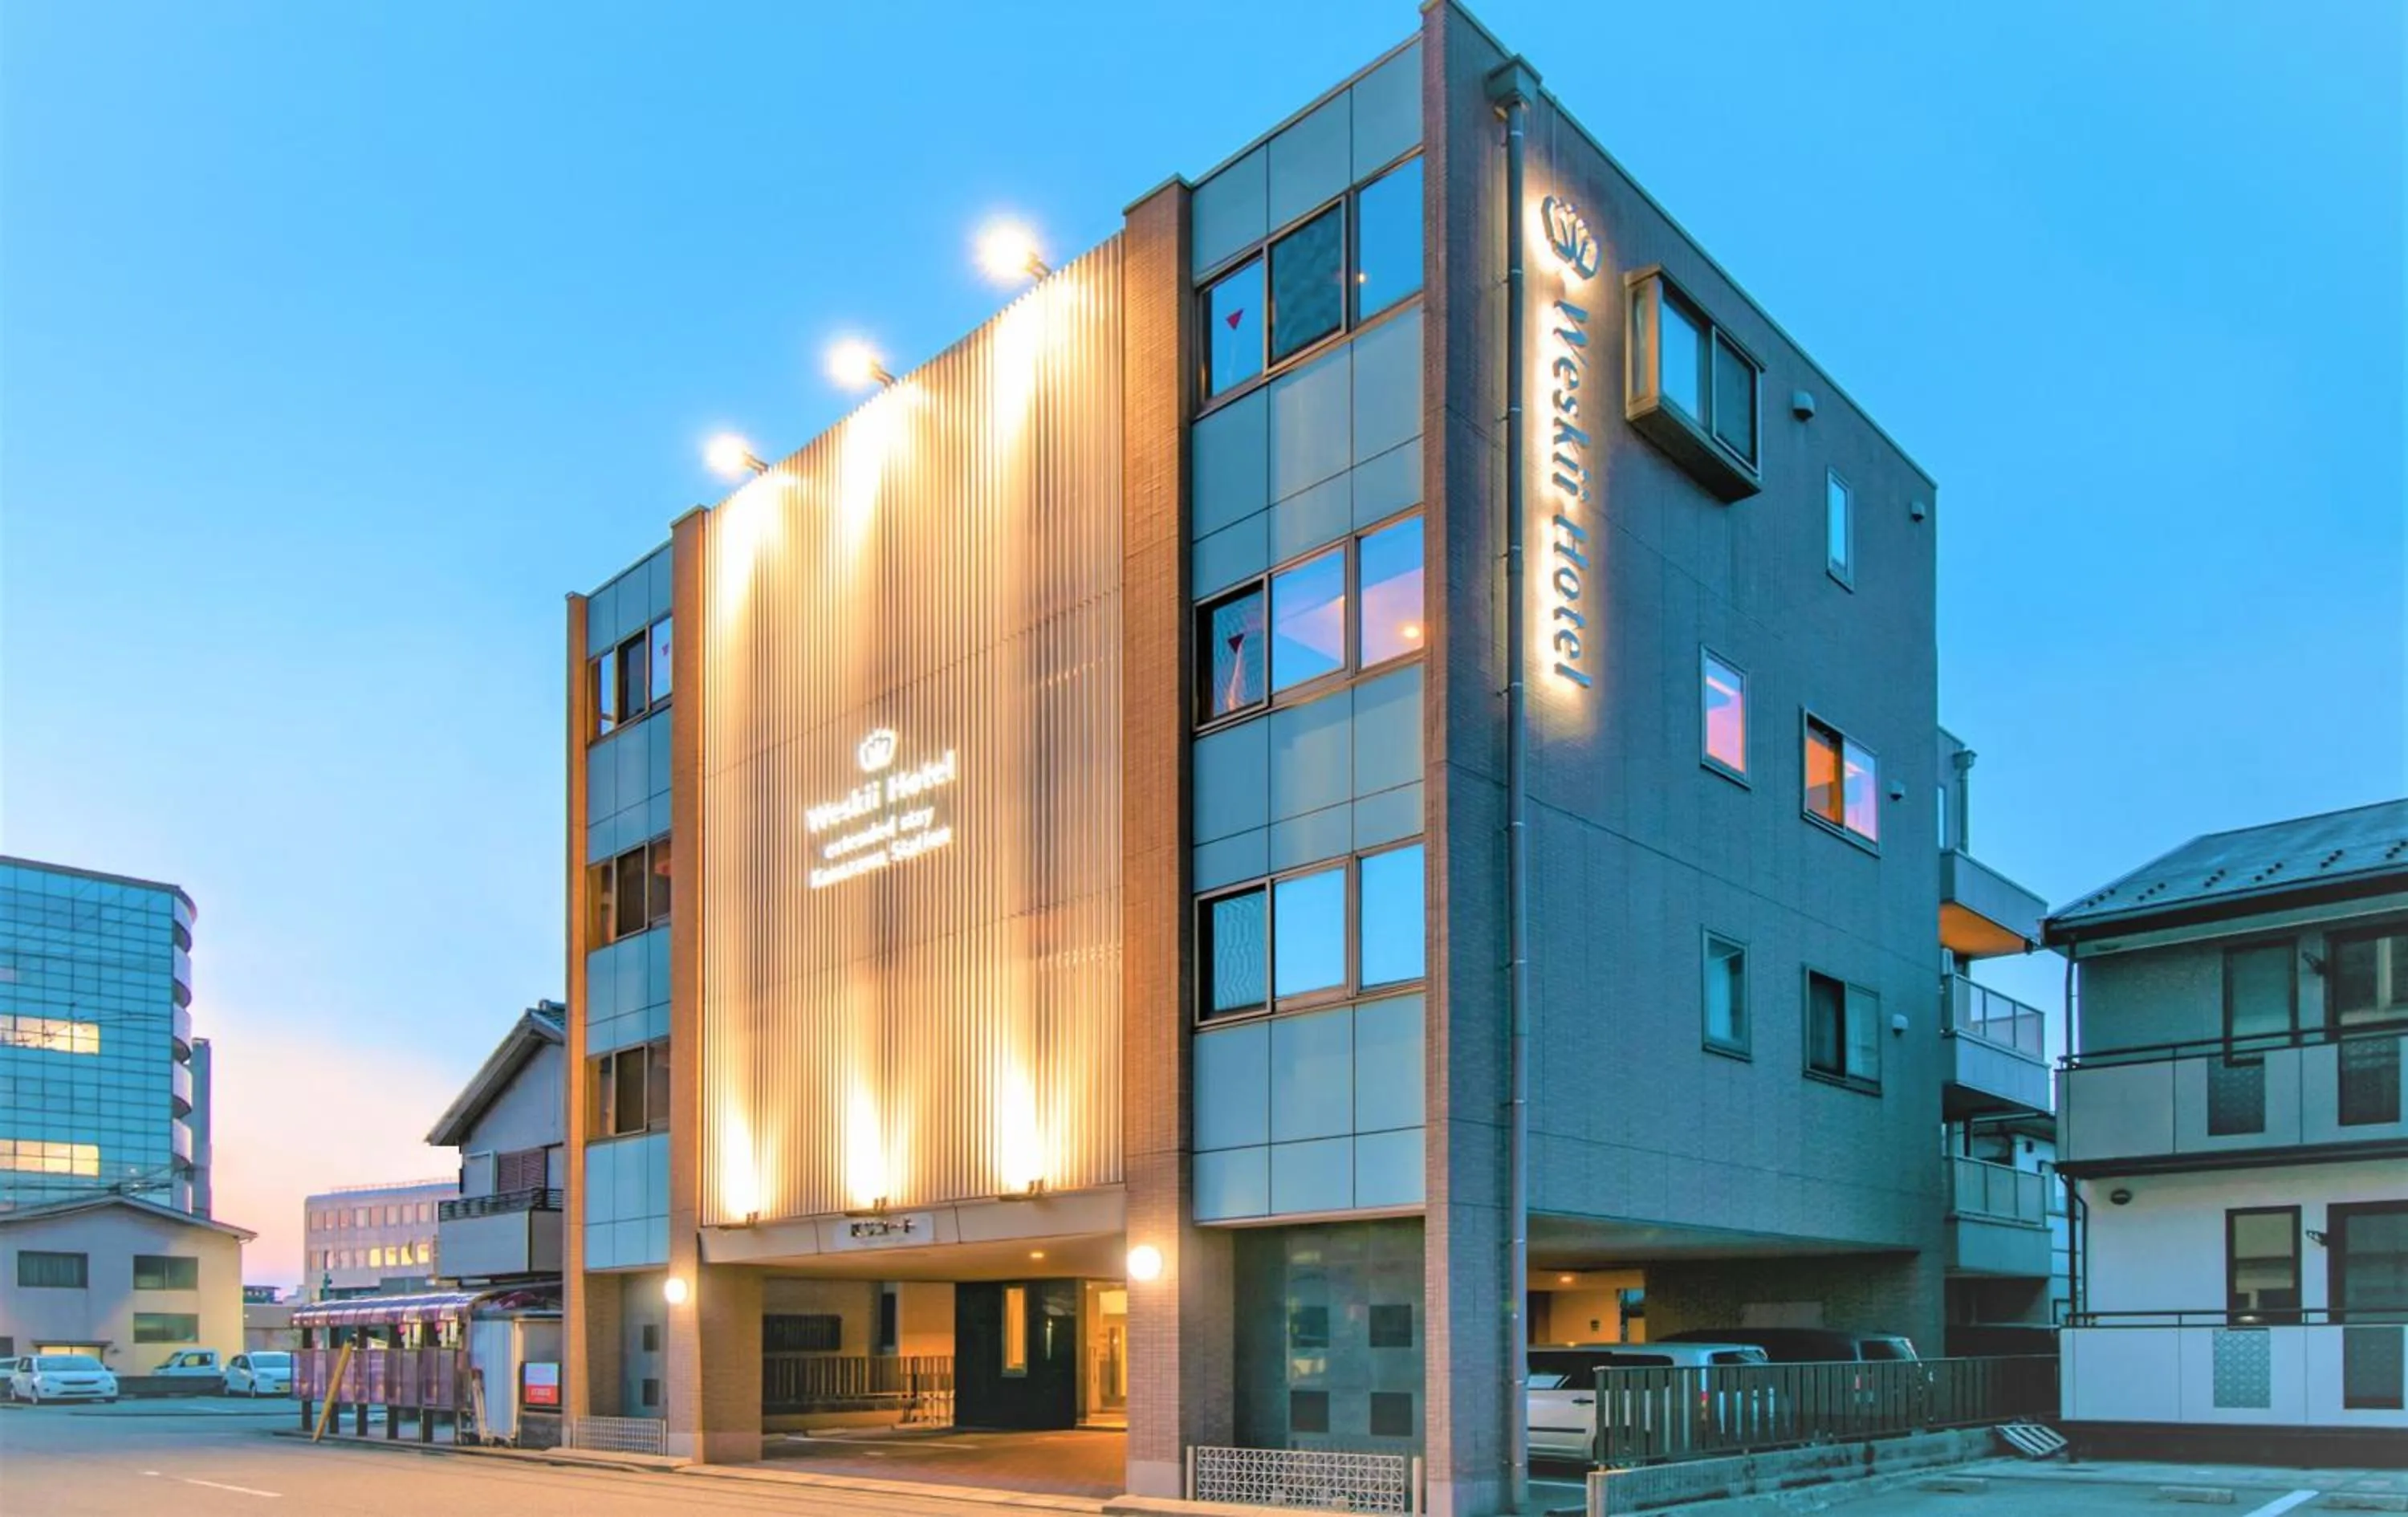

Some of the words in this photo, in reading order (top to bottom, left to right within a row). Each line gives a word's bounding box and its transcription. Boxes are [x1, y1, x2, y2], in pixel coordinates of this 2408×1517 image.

[1552, 299, 1591, 502] Weskii
[1552, 514, 1593, 689] Hotel
[806, 780, 880, 833] Weskii
[887, 749, 955, 802] Hotel
[899, 807, 934, 831] stay
